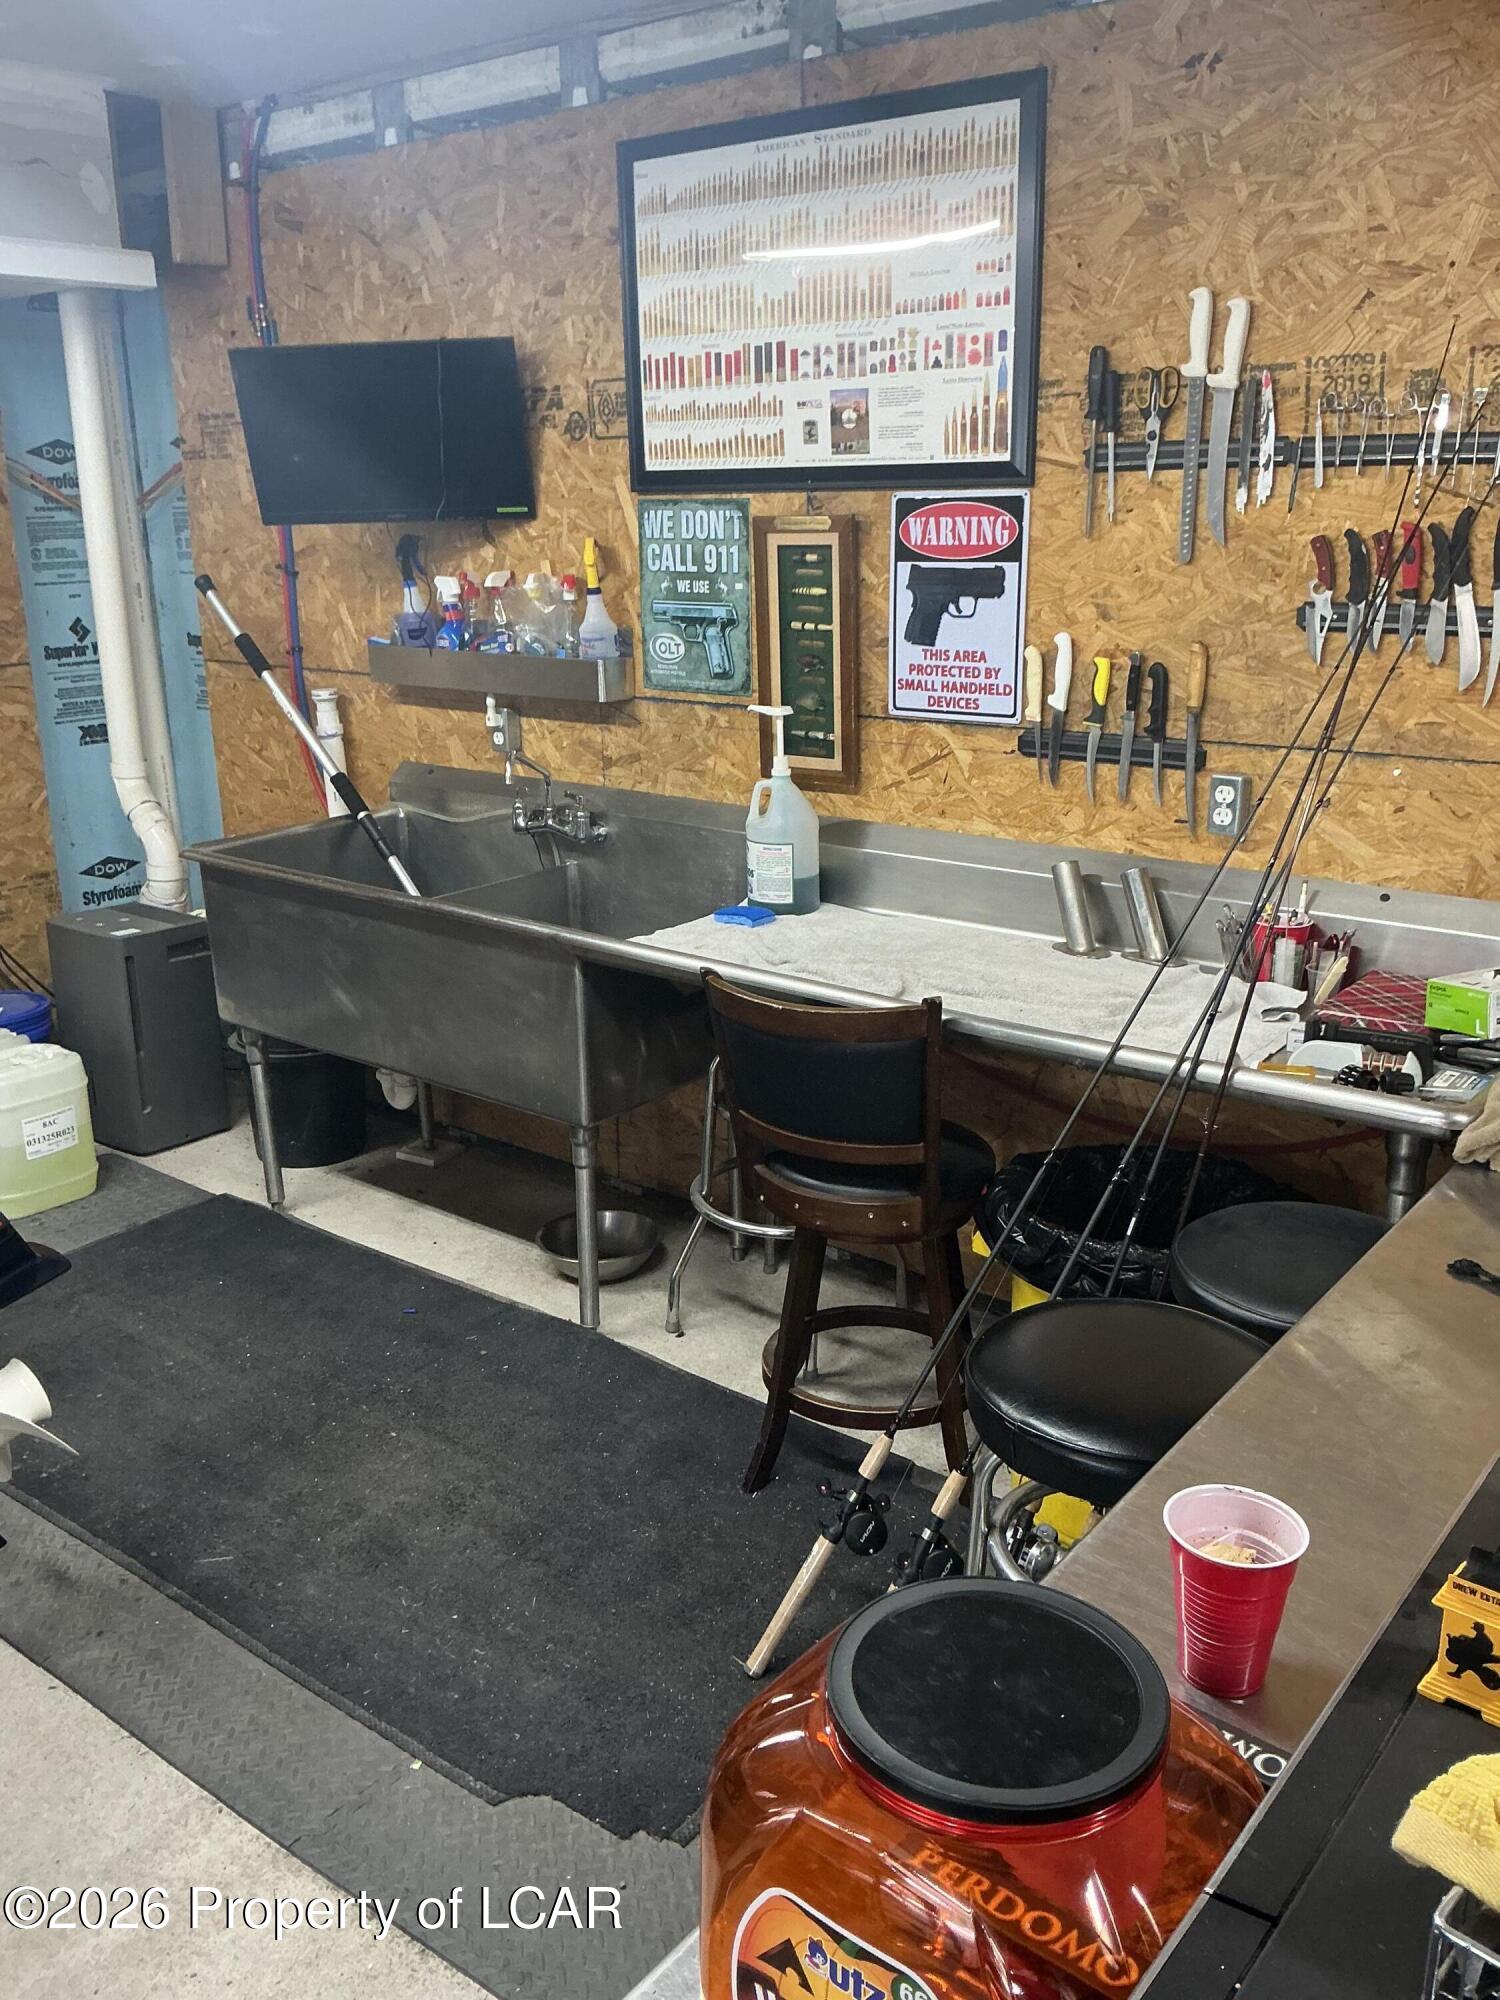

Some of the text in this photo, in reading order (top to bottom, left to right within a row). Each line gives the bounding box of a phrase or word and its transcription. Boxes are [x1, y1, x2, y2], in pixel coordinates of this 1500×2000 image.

[643, 509, 743, 540] WE DON'T
[907, 515, 1010, 546] WARNING
[647, 543, 739, 574] CALL 911
[676, 579, 710, 594] WE USE
[44, 643, 90, 661] Superior
[921, 648, 988, 664] THIS AREA
[908, 663, 1002, 680] PROTECTED BY
[897, 678, 1013, 697] SMALL HANDHELD
[927, 695, 981, 711] DEVICES
[94, 862, 129, 876] DOW
[911, 1838, 1140, 1987] PERDOMO
